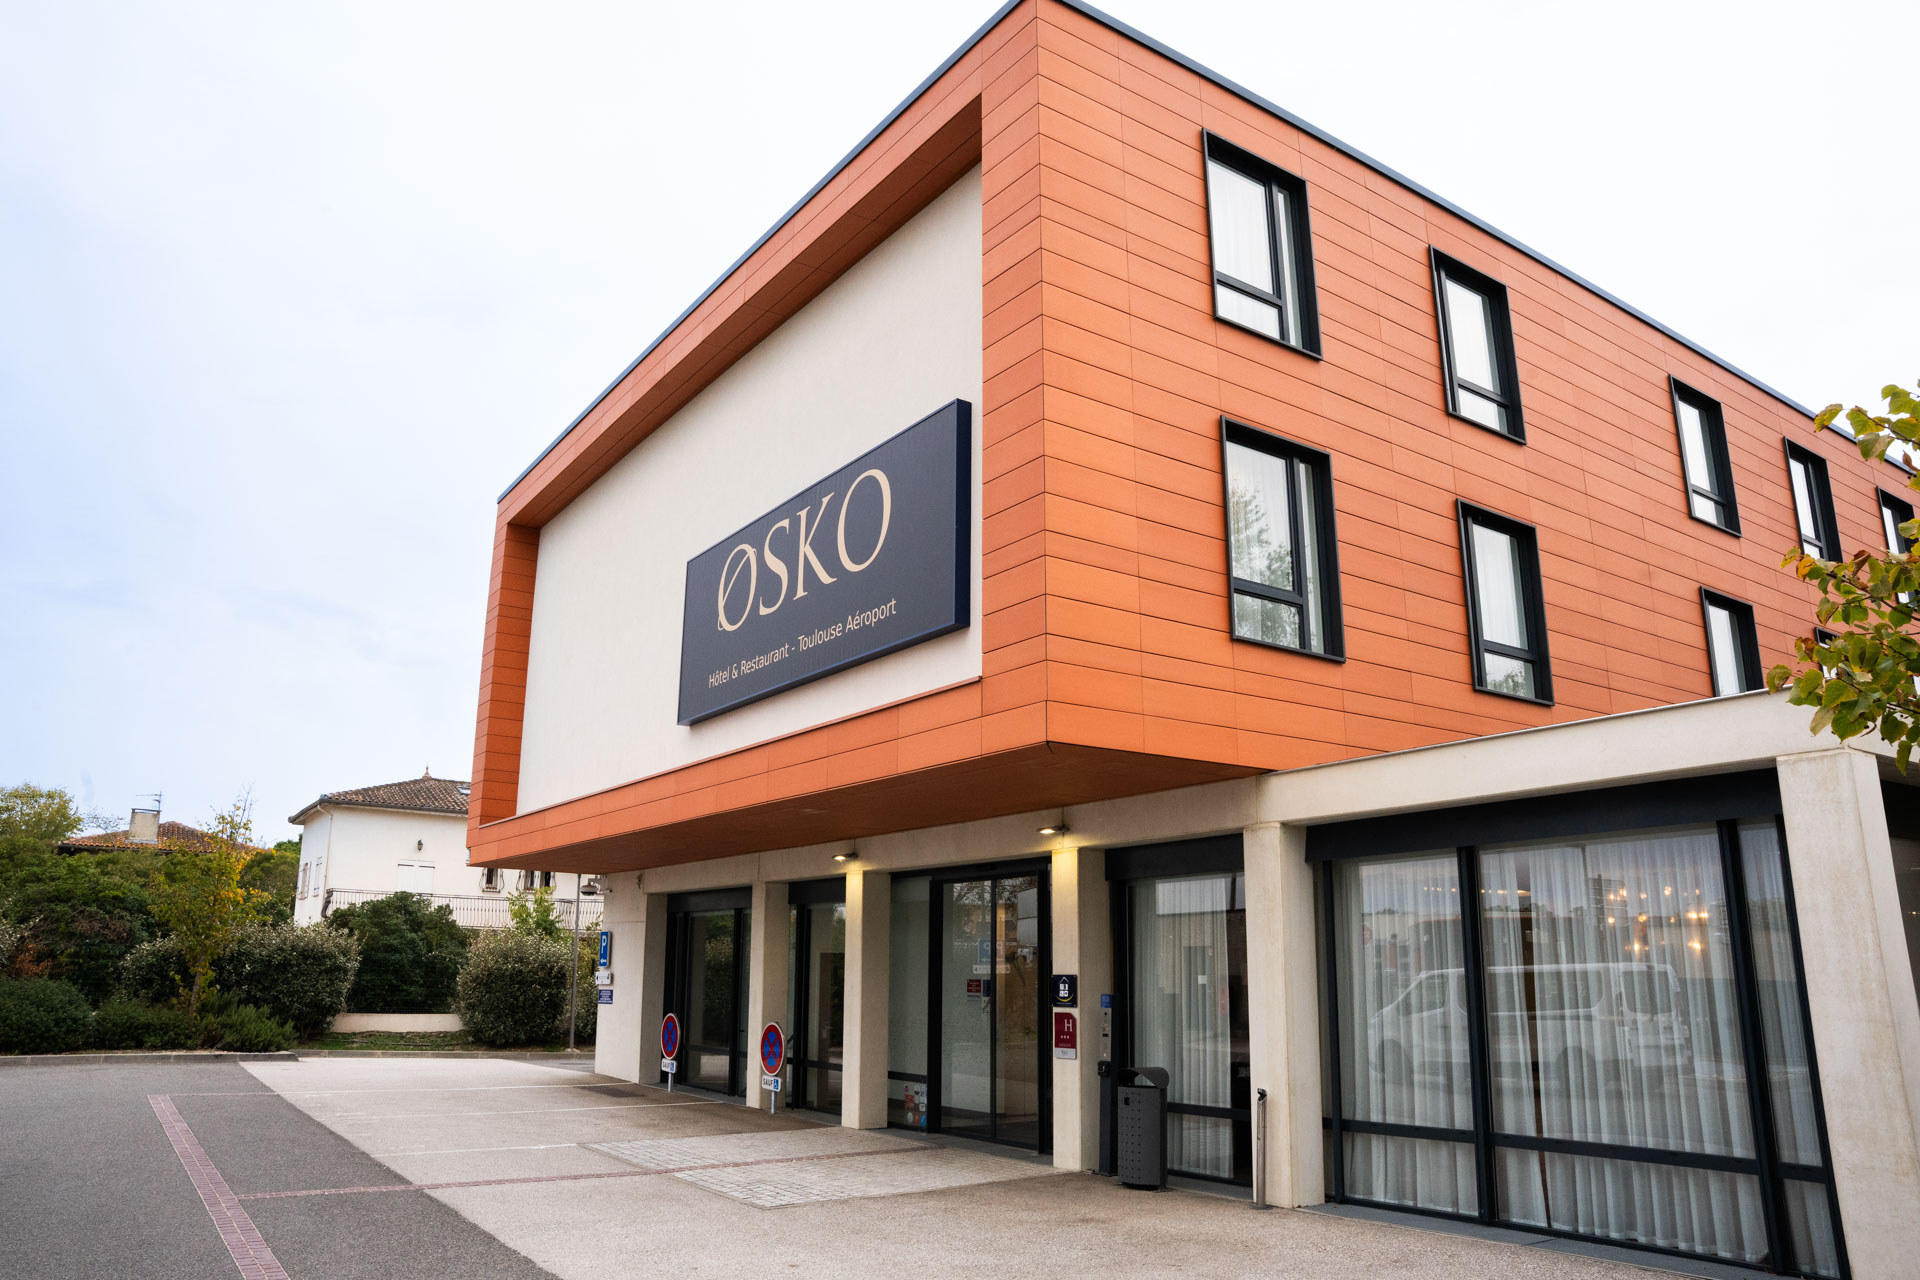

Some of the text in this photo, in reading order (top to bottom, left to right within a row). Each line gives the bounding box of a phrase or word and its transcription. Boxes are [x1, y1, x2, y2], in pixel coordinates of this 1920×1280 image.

[708, 666, 730, 689] Hôtel
[731, 663, 739, 679] &
[741, 643, 790, 676] Restaurant
[798, 623, 843, 652] Toulouse
[845, 598, 897, 633] Aéroport
[602, 935, 607, 954] P
[1064, 1019, 1073, 1032] H
[763, 1077, 774, 1088] SAUF
